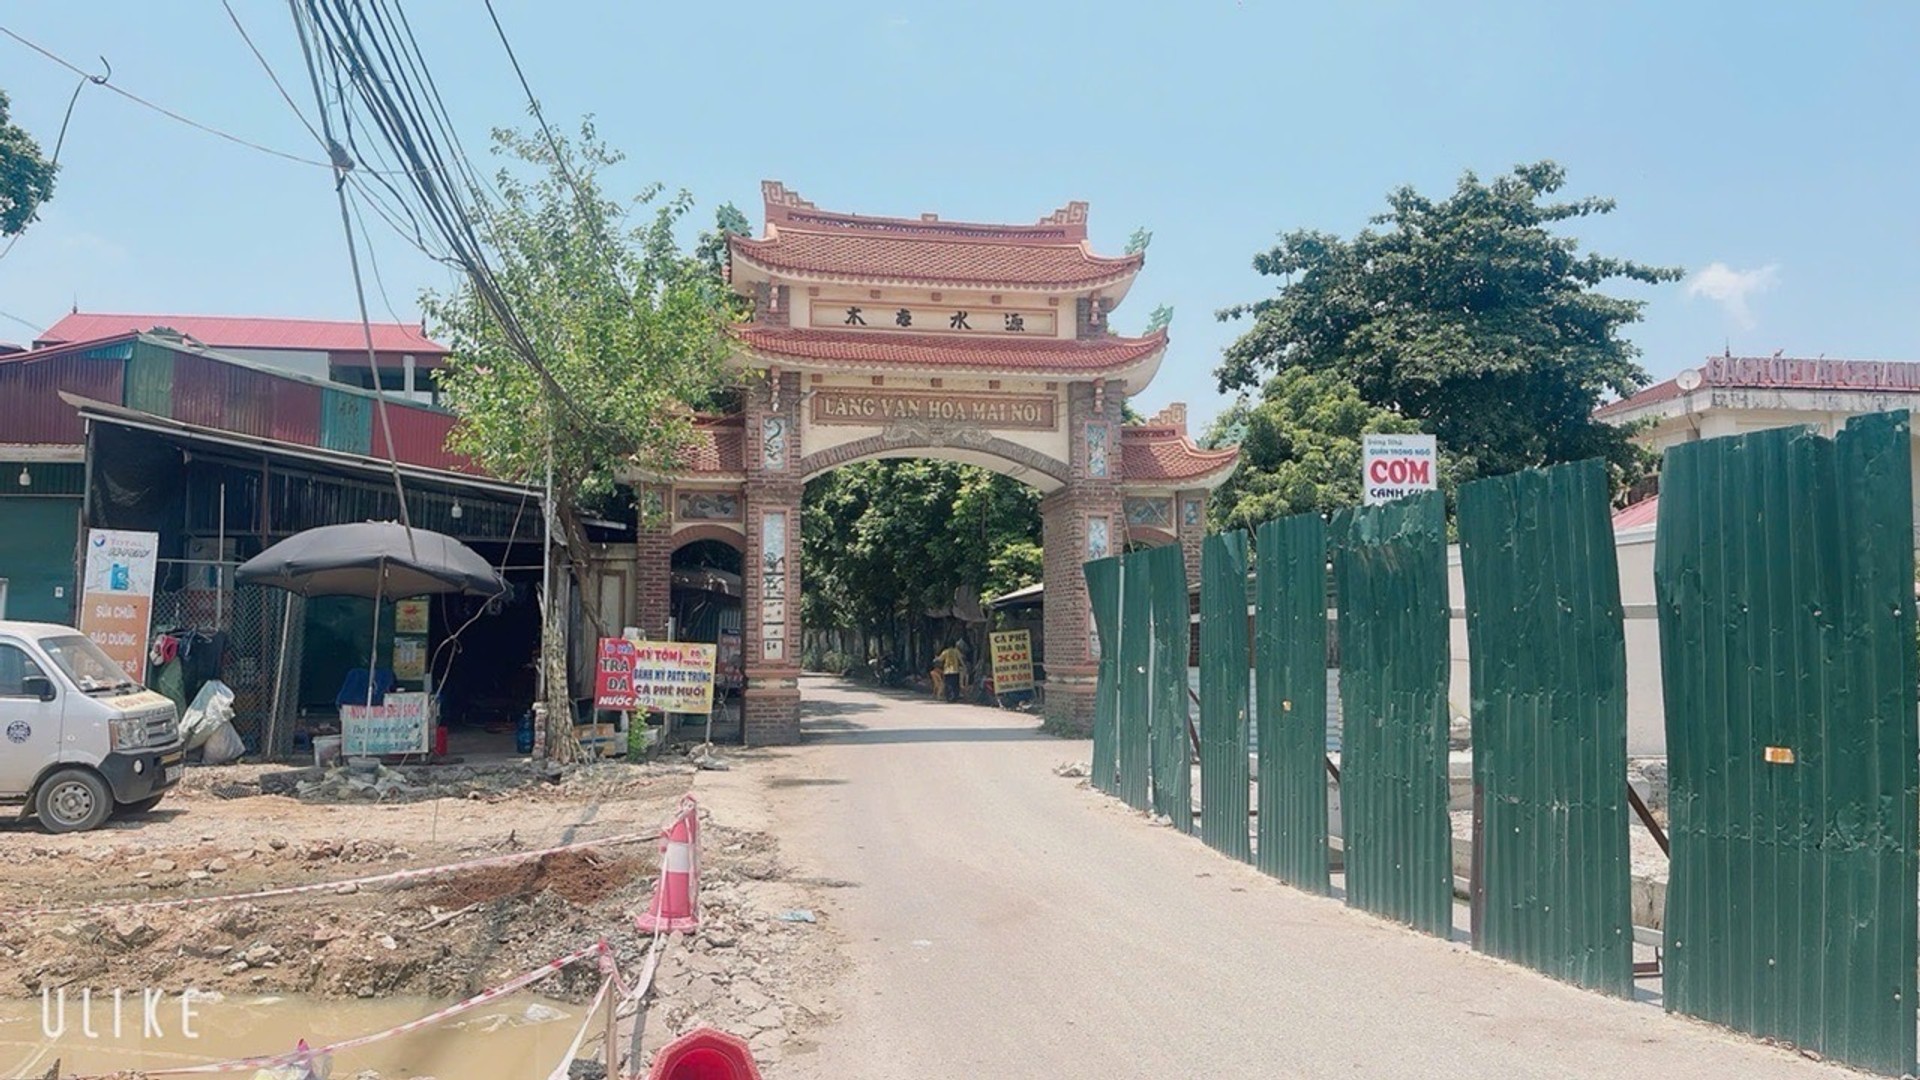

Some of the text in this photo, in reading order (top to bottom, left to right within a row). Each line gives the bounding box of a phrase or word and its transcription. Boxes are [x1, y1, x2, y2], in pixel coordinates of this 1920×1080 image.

[972, 402, 1006, 421] MAI
[1370, 457, 1430, 484] CƠM
[1370, 488, 1404, 498] CANH
[600, 655, 630, 674] TRÀ
[607, 673, 629, 691] ĐÁ
[599, 695, 633, 706] NƯỚC
